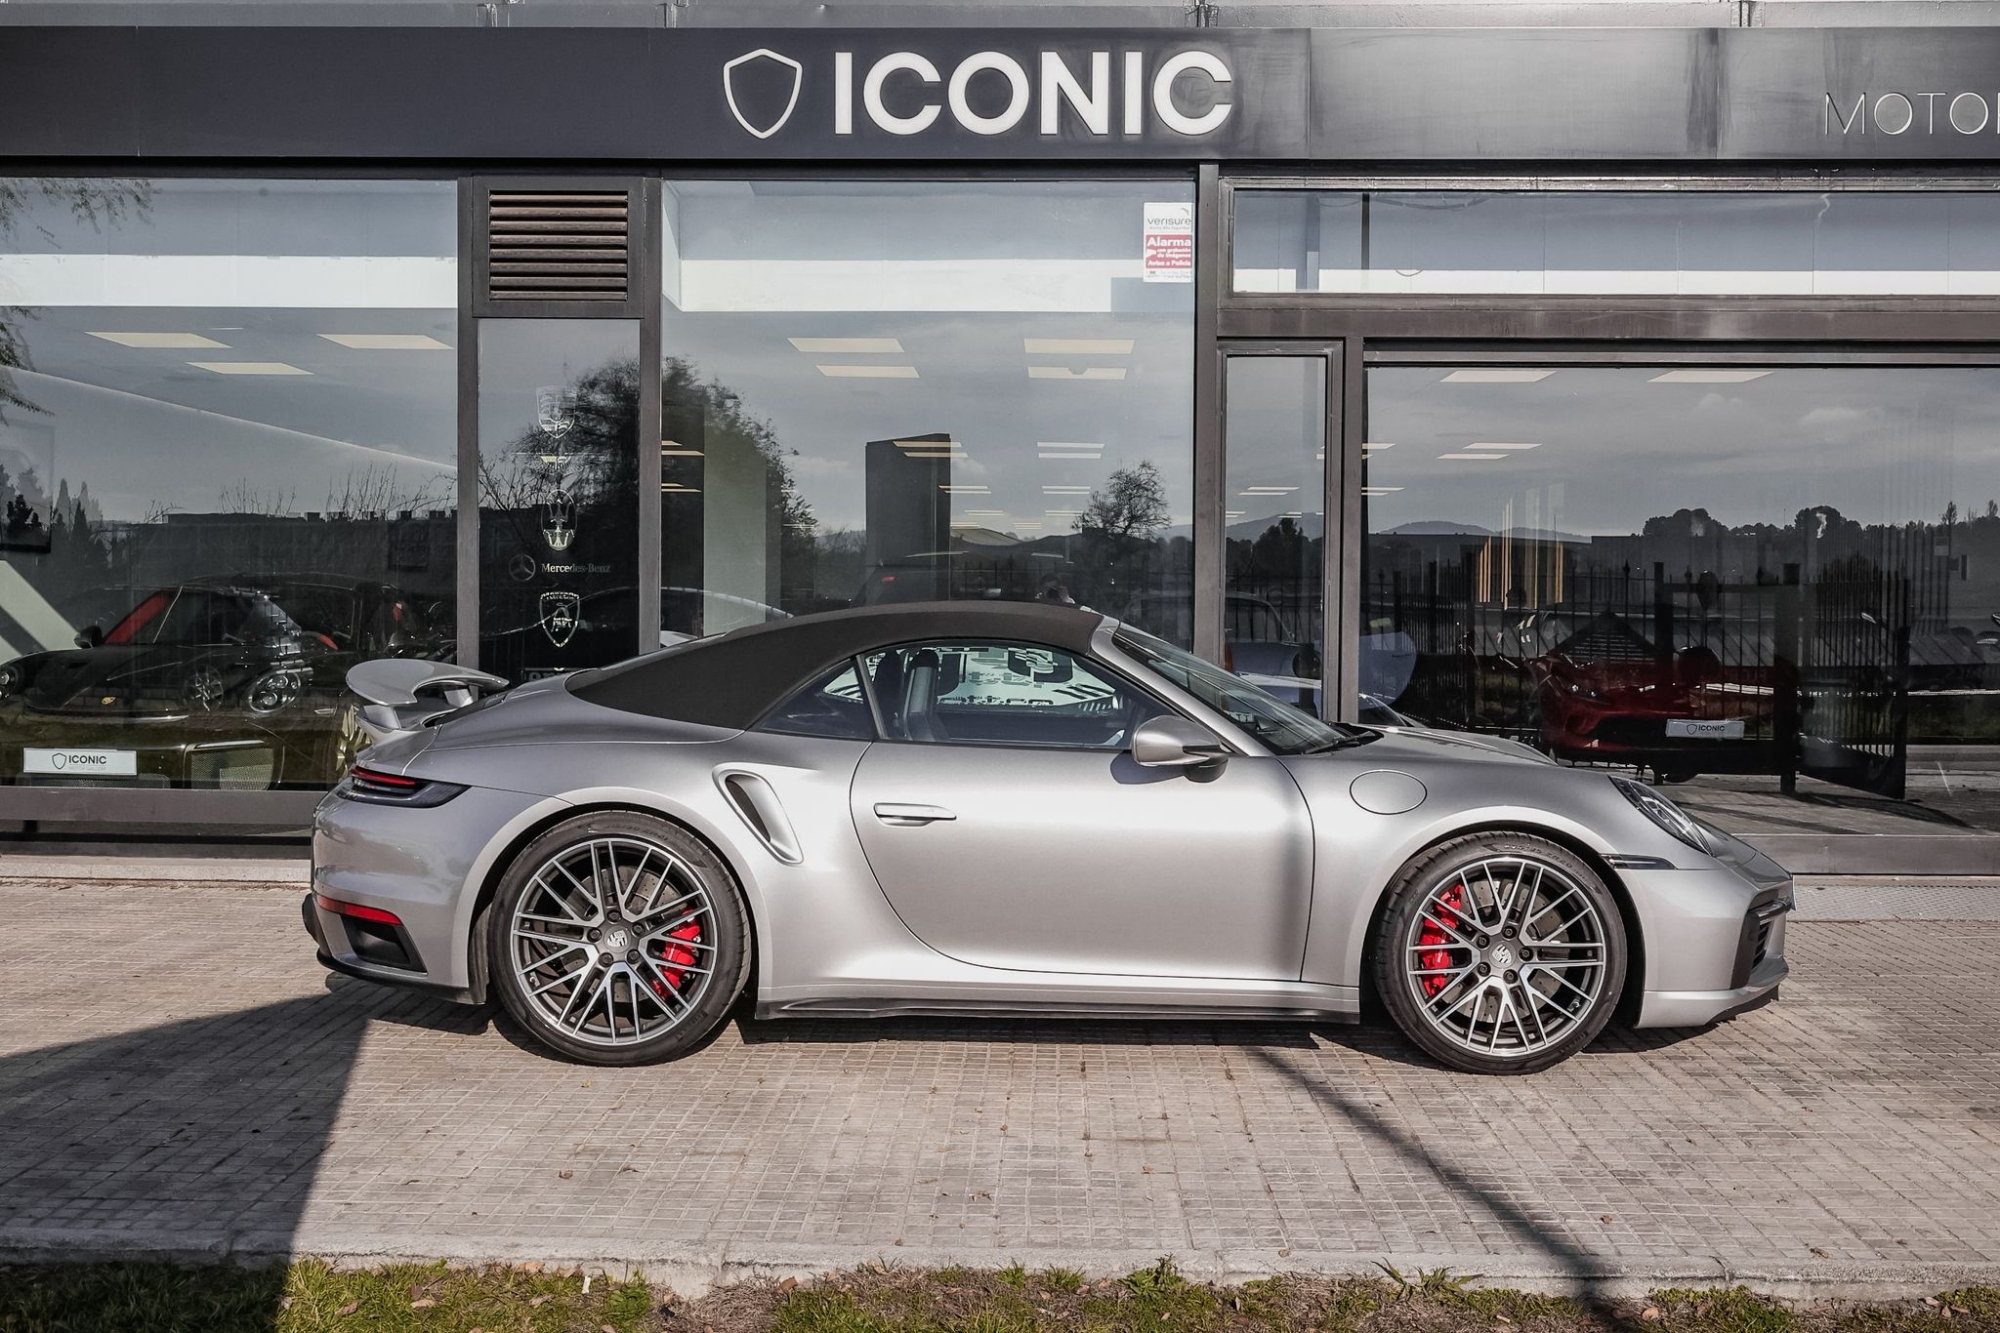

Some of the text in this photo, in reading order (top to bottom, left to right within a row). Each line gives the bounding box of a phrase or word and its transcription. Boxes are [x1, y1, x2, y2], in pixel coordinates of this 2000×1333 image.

[835, 51, 1232, 135] ICONIC
[1825, 92, 2000, 135] MOTO
[1147, 217, 1192, 225] verisure
[1147, 236, 1191, 246] Alarma
[541, 563, 611, 573] Mercedes-Benz
[68, 754, 107, 764] ICONIC
